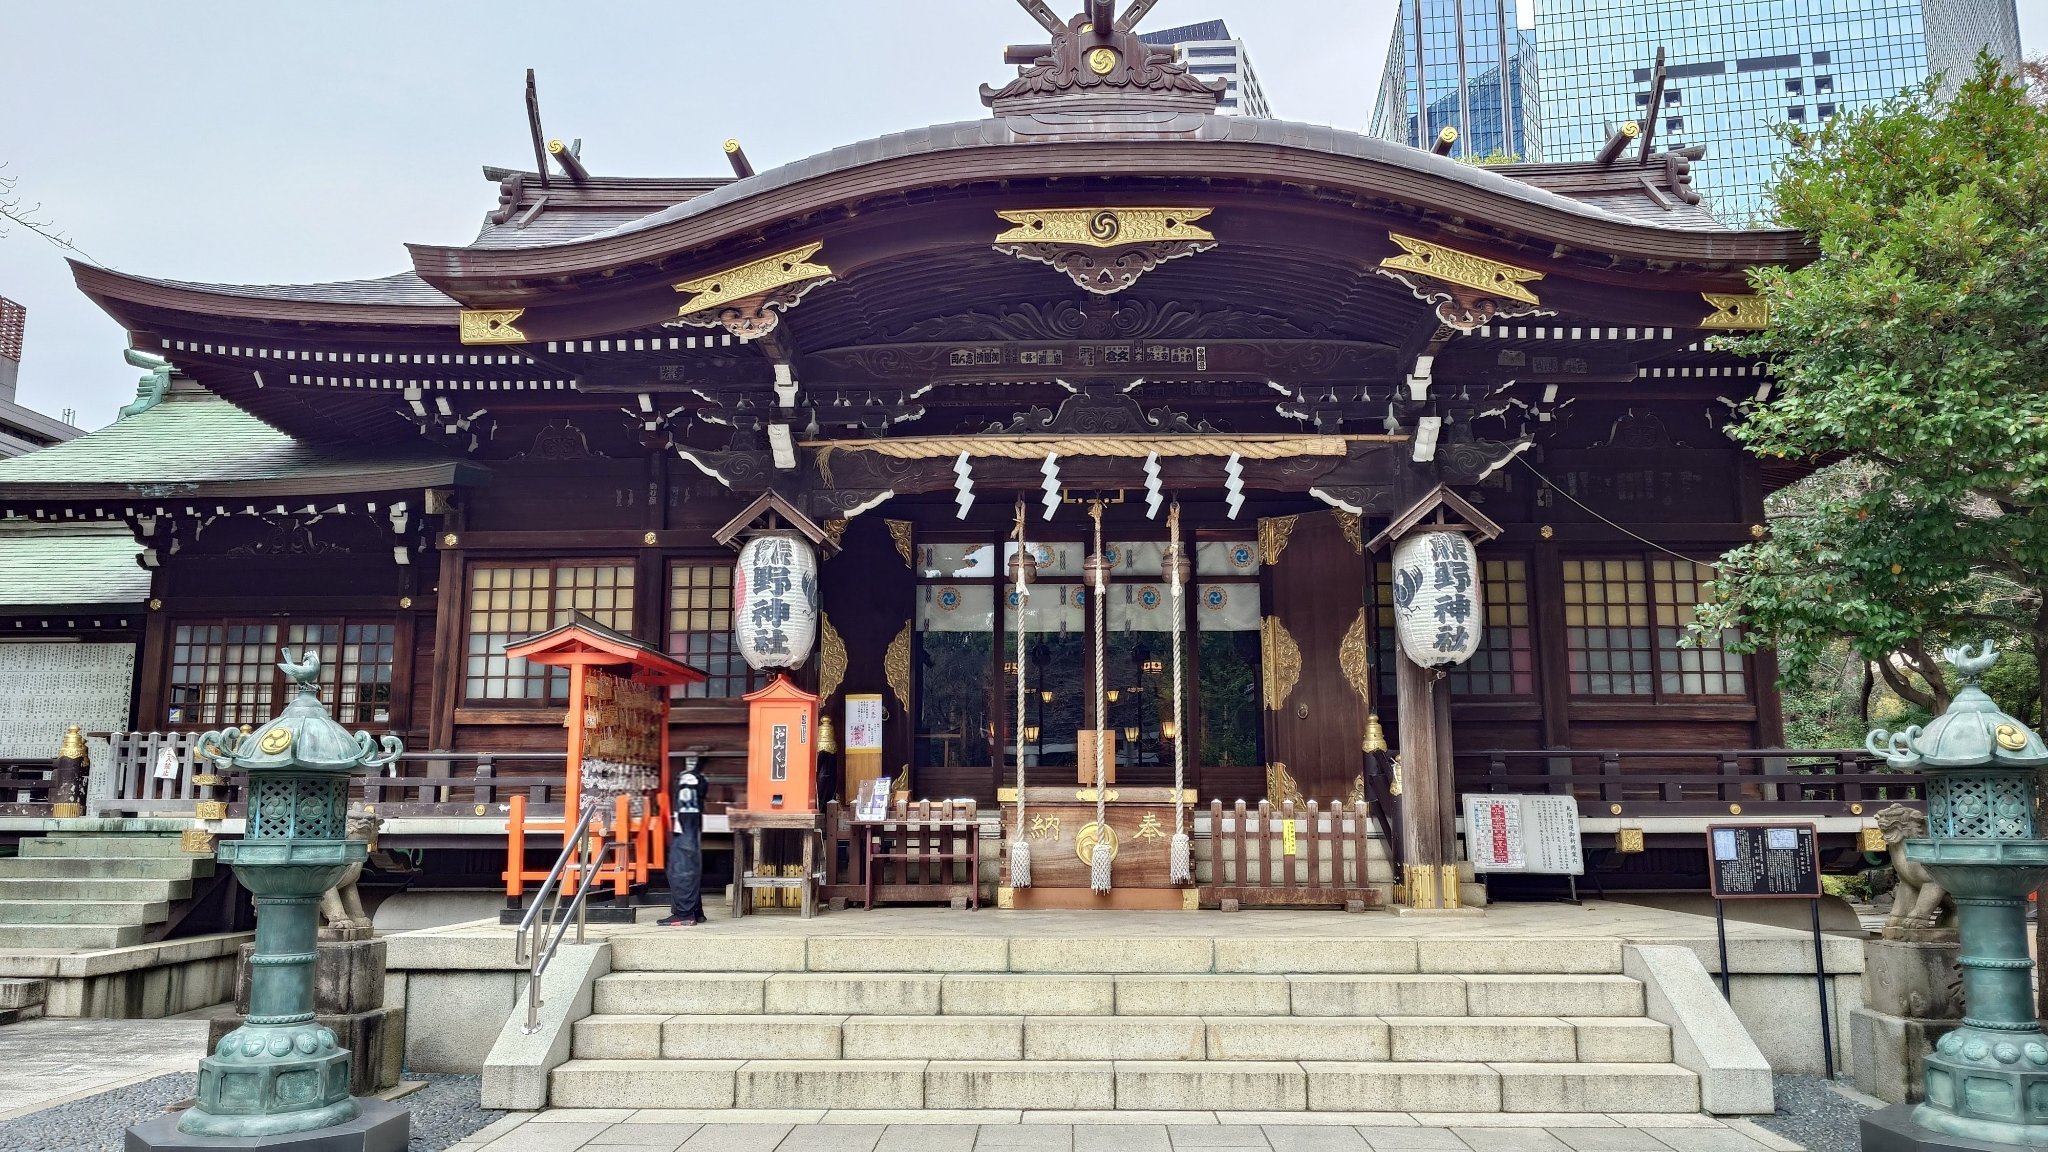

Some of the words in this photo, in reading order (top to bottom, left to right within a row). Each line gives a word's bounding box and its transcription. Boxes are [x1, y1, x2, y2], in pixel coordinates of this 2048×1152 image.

[751, 539, 792, 655] 熊野神社
[1428, 534, 1471, 653] 熊野神社
[773, 727, 786, 779] おみくじ
[1030, 812, 1062, 842] 納
[1132, 811, 1167, 844] 奉
